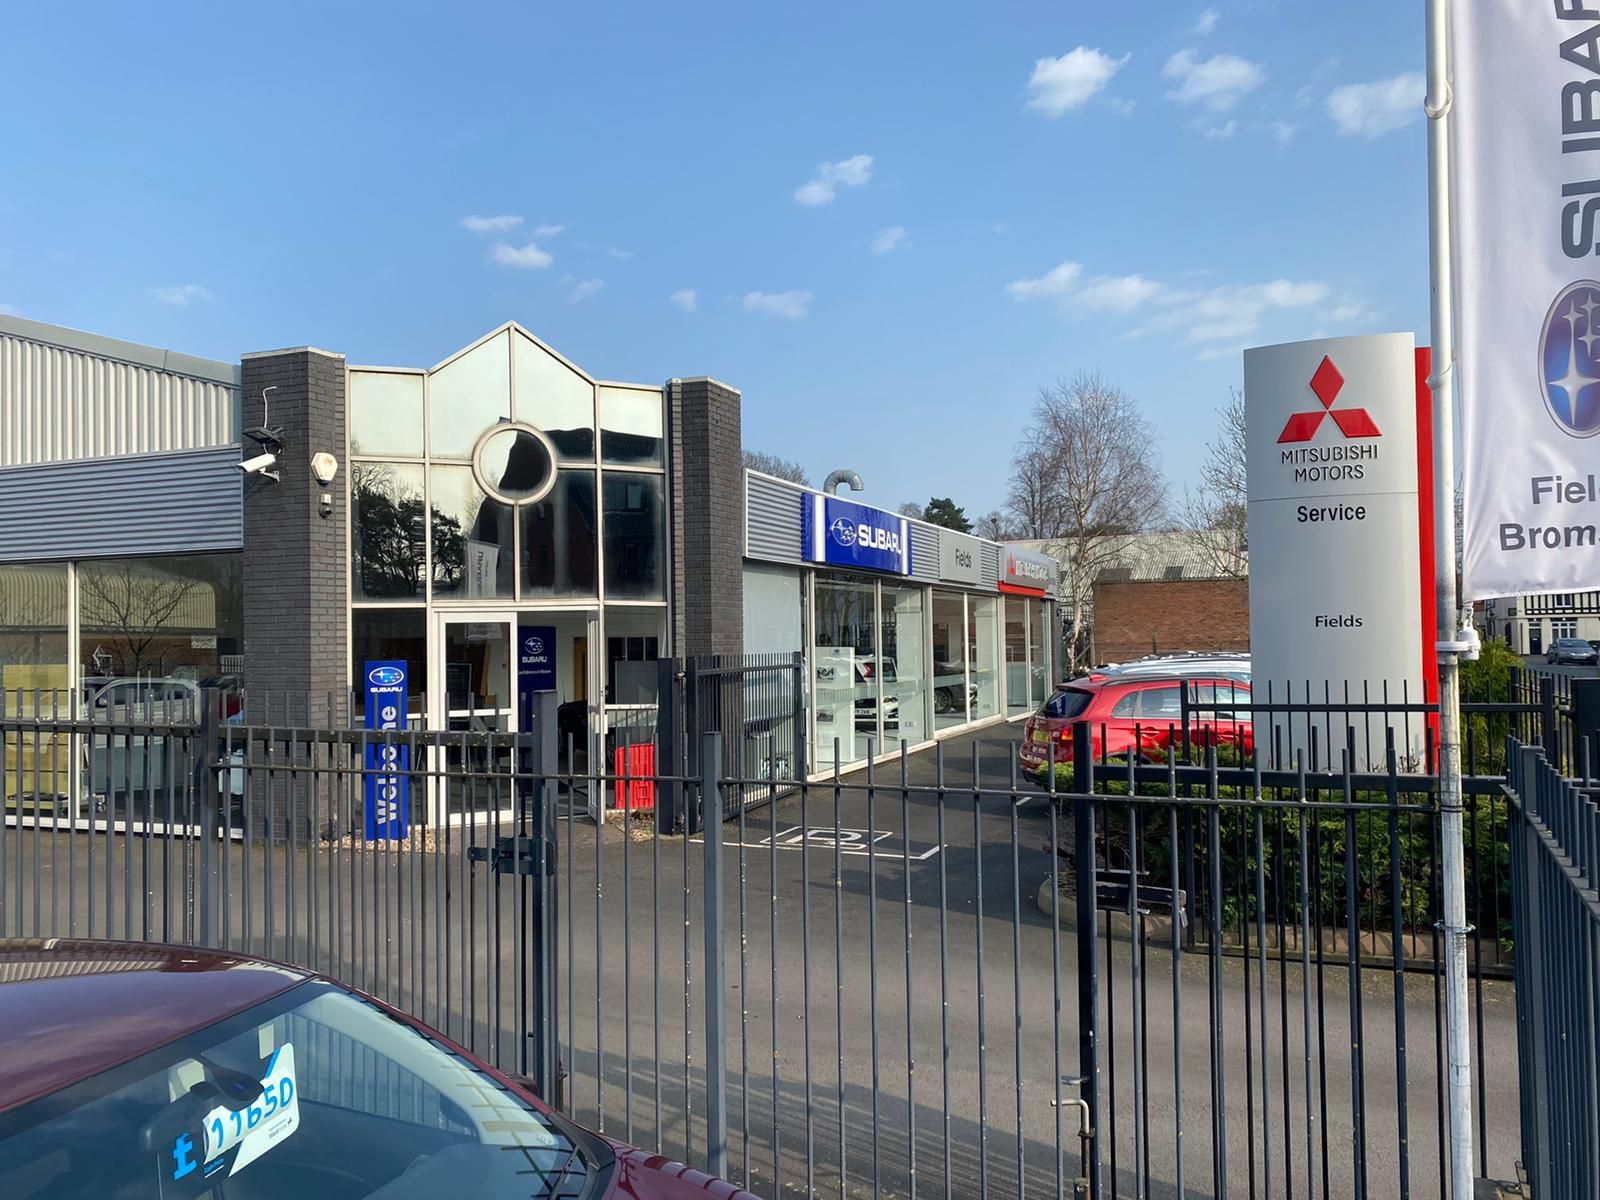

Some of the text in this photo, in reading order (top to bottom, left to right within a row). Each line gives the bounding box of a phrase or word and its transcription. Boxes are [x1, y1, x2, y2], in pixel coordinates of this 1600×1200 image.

[1281, 444, 1379, 464] MITSUBISHI
[1295, 464, 1365, 482] MOTORS
[1531, 474, 1600, 505] Fiel
[1297, 503, 1366, 523] Service
[1499, 522, 1600, 551] Brom
[955, 548, 972, 569] Fields
[1315, 614, 1363, 628] Fields
[521, 655, 548, 663] SUBARU
